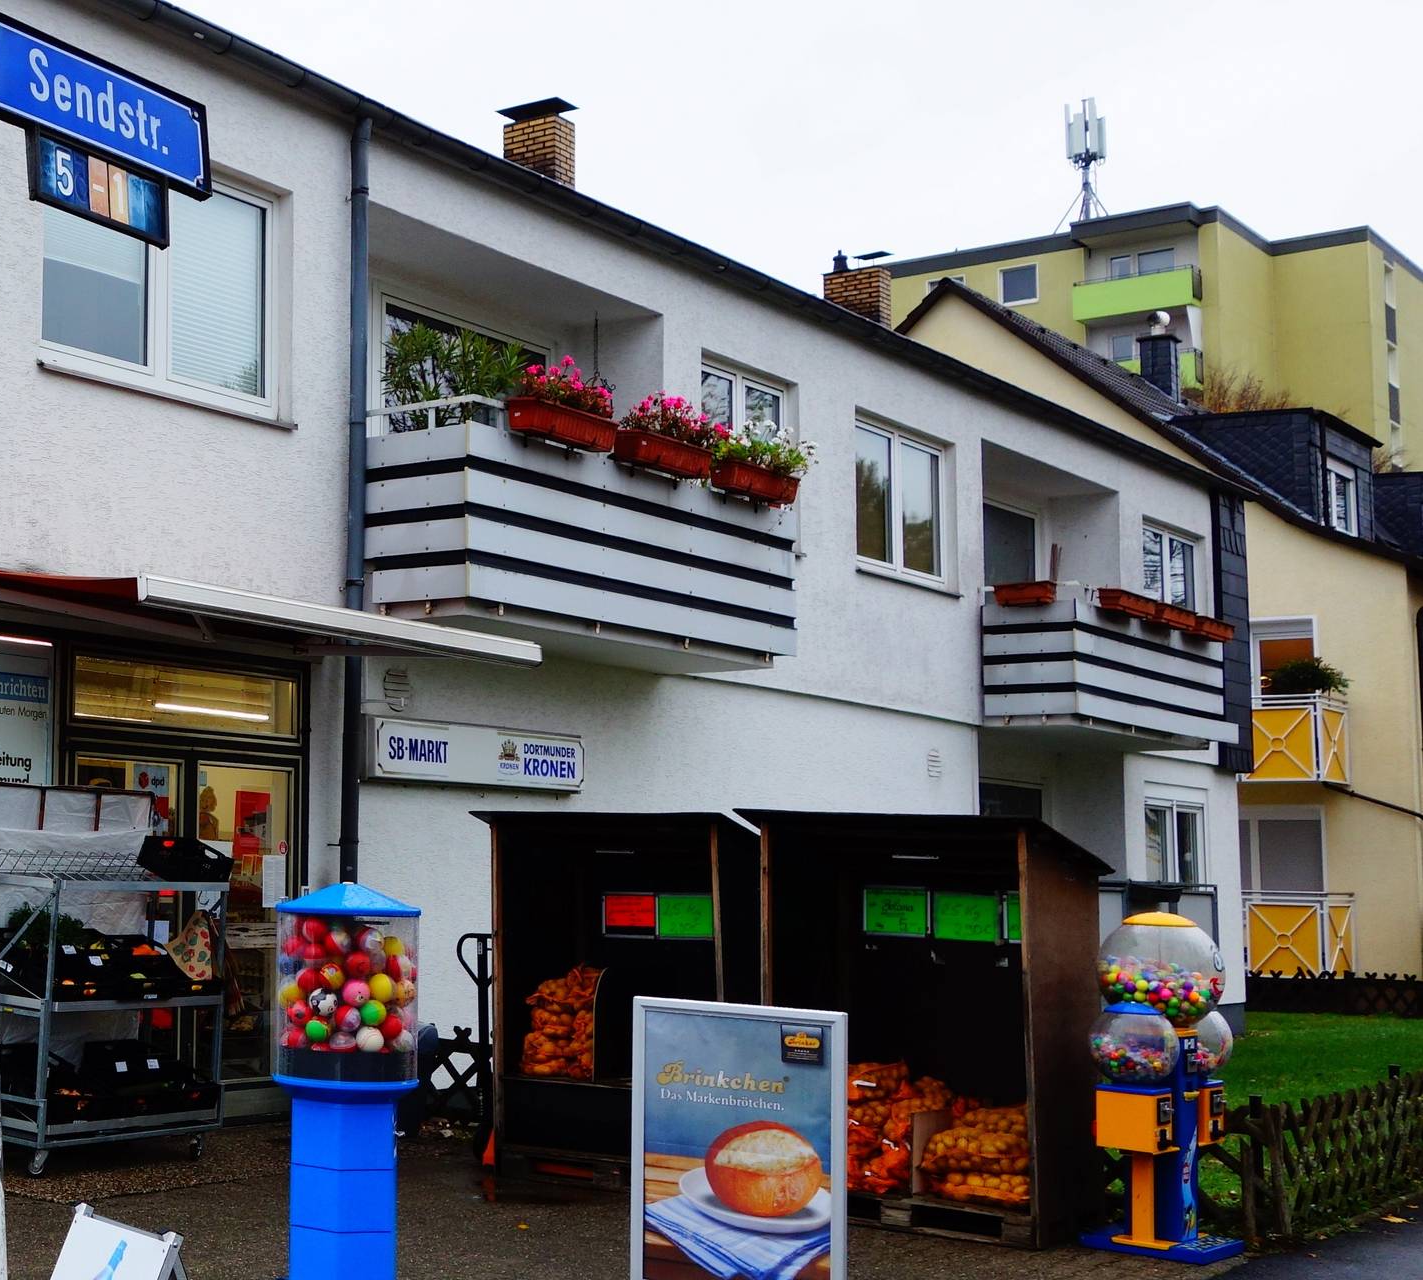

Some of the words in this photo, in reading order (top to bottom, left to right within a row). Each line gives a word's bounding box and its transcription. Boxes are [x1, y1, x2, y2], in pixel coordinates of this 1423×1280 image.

[28, 48, 169, 156] Sendstr.
[523, 743, 576, 759] DORTMUNDER
[523, 759, 576, 779] KRONEN
[151, 774, 165, 788] dpd
[660, 1088, 682, 1101] Das
[685, 1091, 785, 1112] Markenbrötchen.
